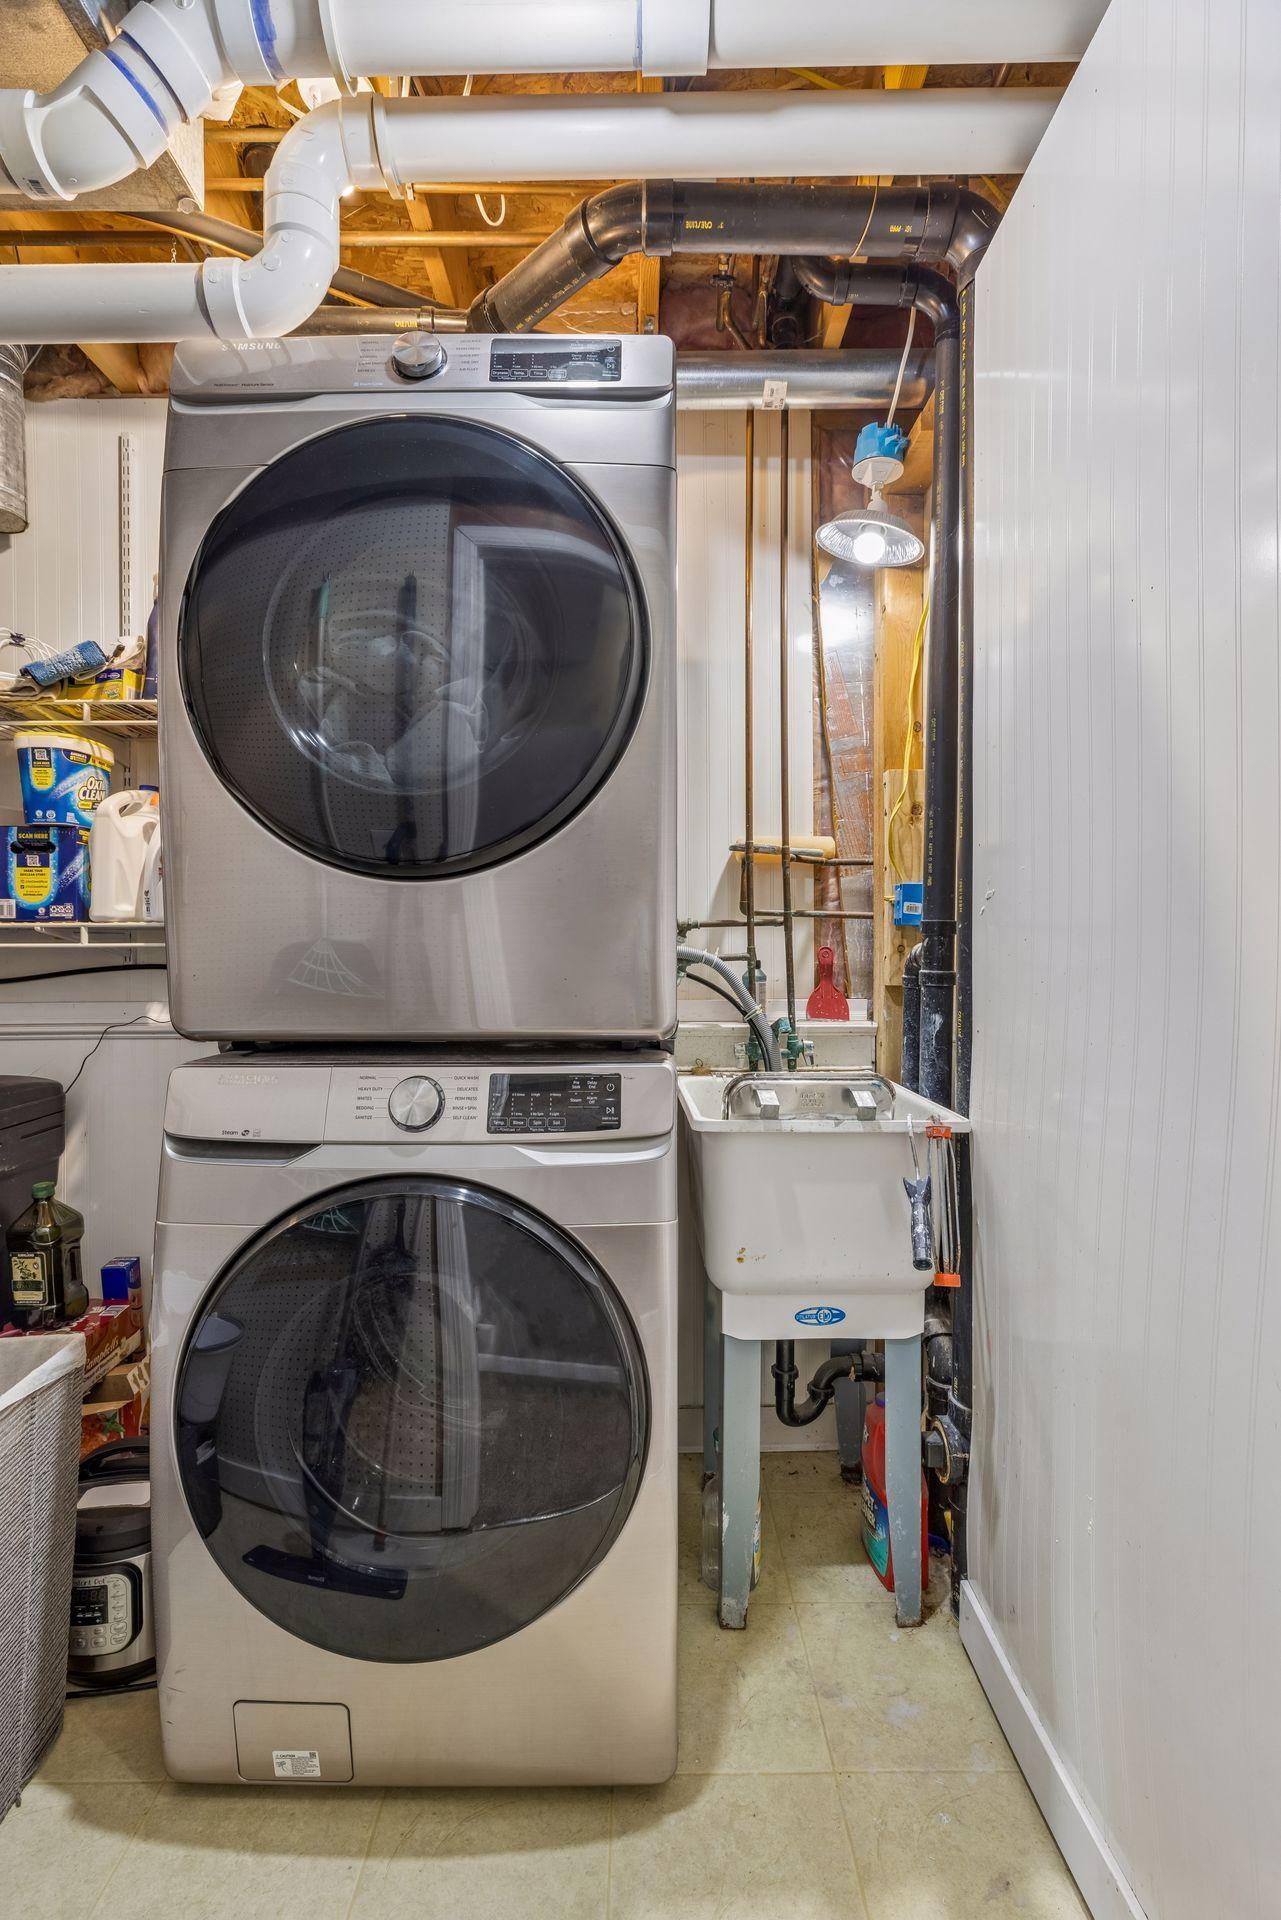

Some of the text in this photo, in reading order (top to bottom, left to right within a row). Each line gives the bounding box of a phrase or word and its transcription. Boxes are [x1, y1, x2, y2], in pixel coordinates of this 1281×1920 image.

[221, 342, 281, 352] SAMSUNG
[87, 776, 103, 790] OXI
[79, 786, 107, 801] CLEAN
